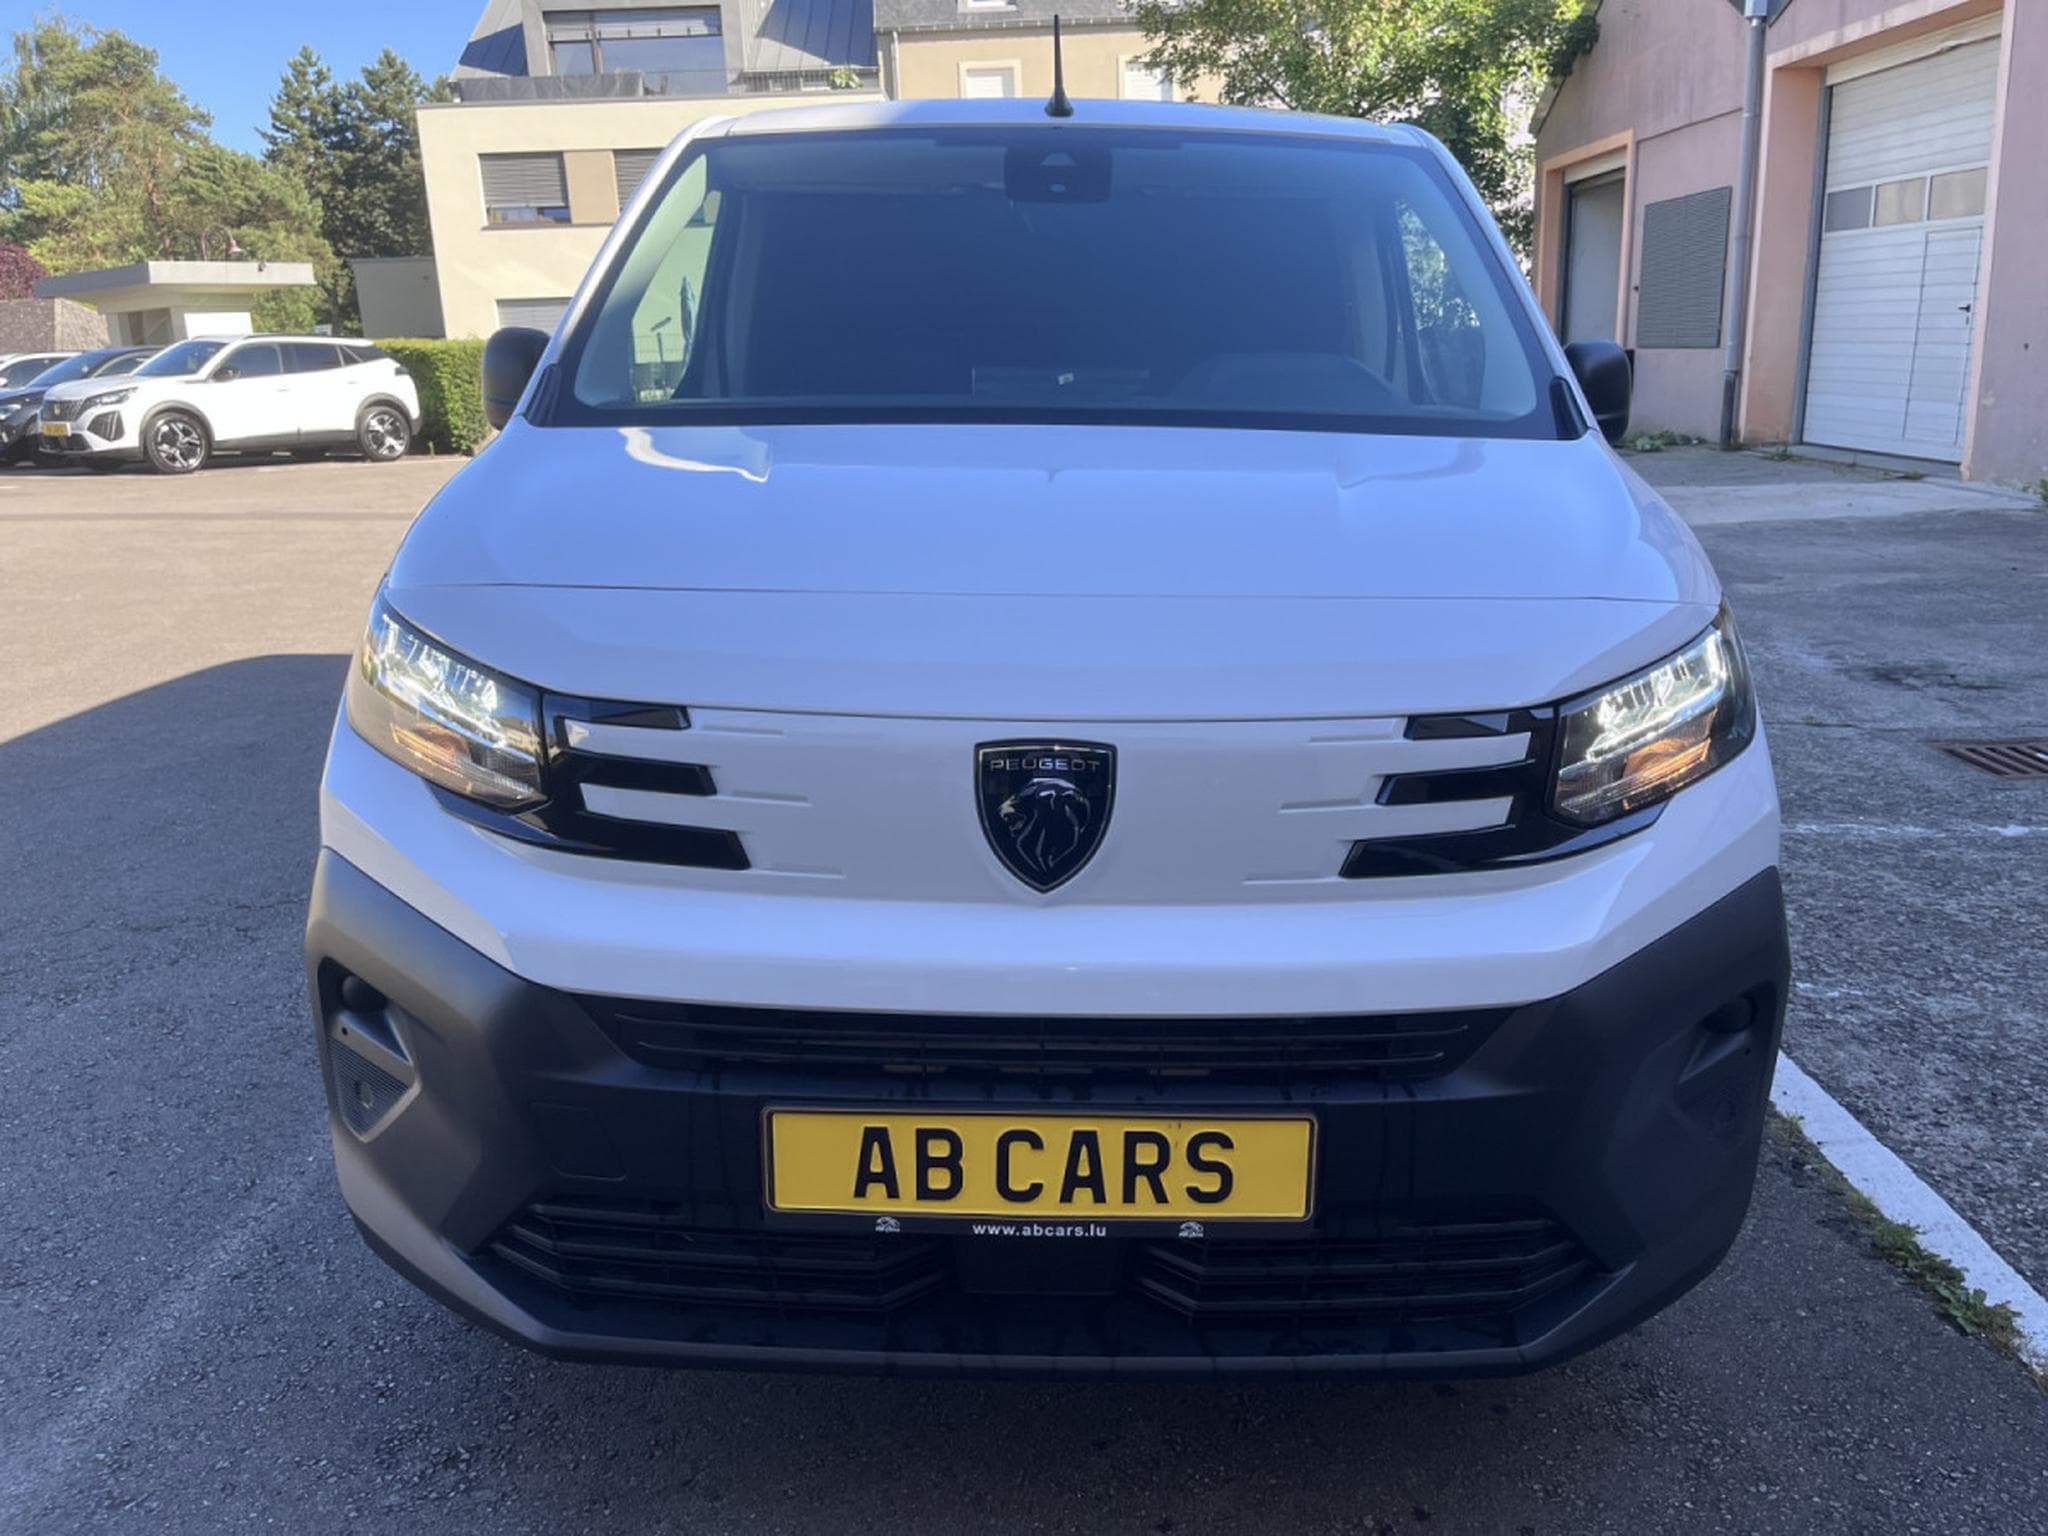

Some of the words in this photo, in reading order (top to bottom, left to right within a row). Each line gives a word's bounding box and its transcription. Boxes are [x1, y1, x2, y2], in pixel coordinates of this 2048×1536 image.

[990, 757, 1101, 772] PEUGEOT
[853, 1126, 964, 1201] AB
[995, 1129, 1235, 1204] CARS
[972, 1222, 1108, 1238] www.abcars.lu
